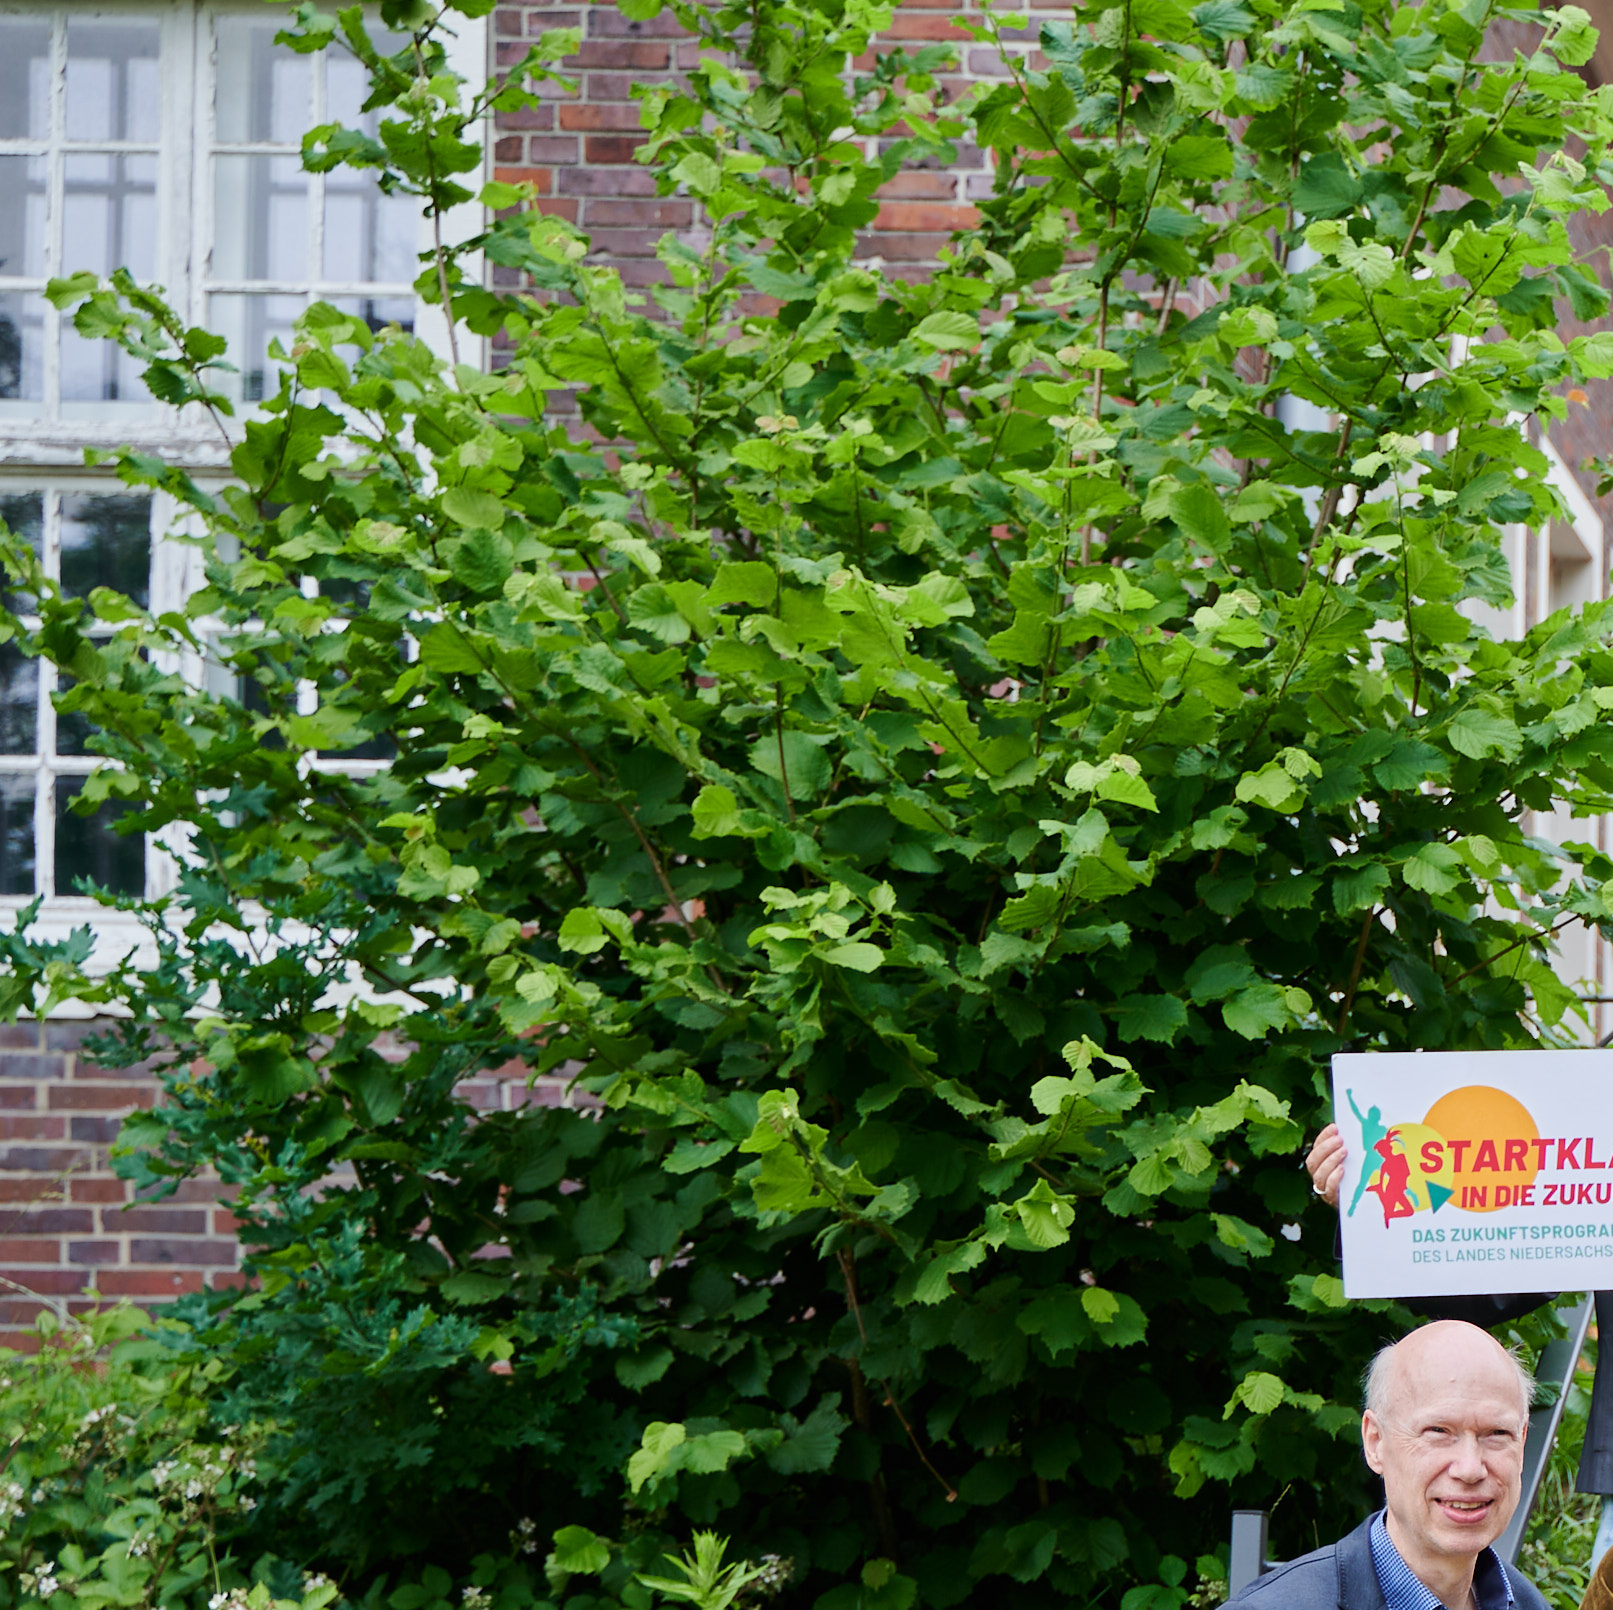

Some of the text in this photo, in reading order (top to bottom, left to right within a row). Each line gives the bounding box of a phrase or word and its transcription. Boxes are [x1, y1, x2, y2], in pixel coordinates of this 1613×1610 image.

[1461, 1185, 1487, 1208] IN
[1494, 1184, 1536, 1207] DIE
[1412, 1228, 1446, 1243] DAS
[1412, 1249, 1442, 1264] DES
[1445, 1247, 1506, 1262] LANDES
